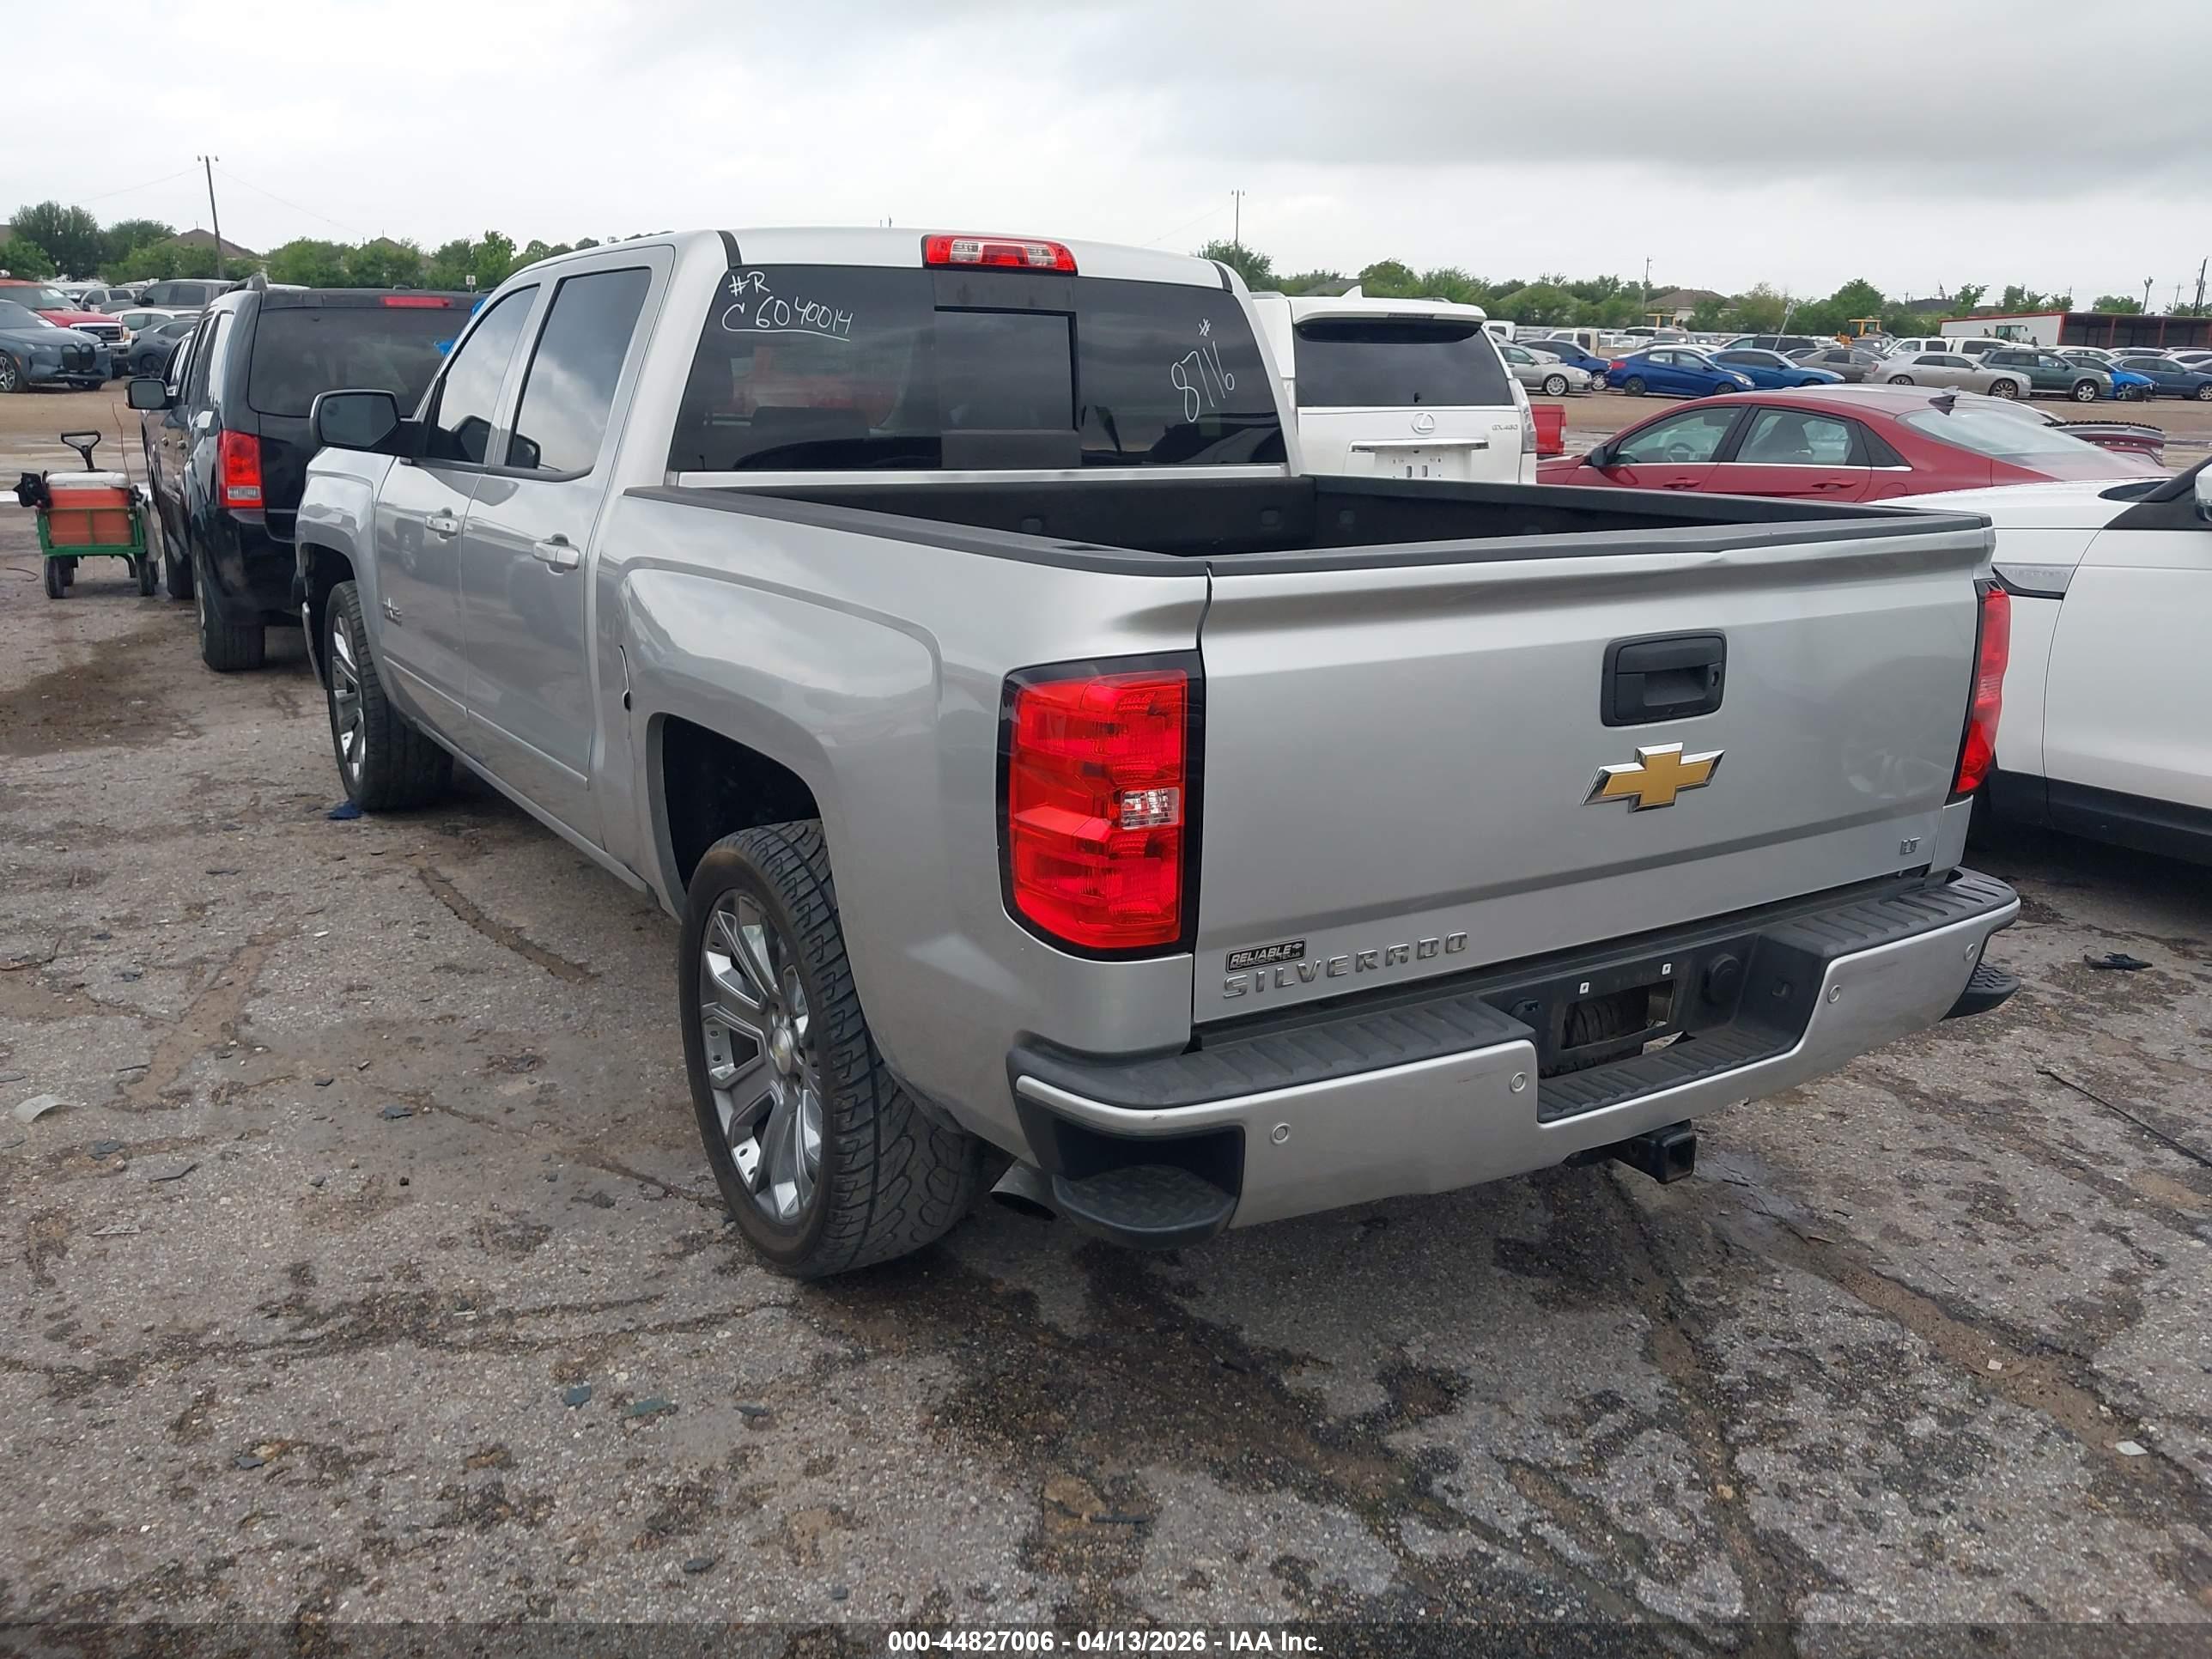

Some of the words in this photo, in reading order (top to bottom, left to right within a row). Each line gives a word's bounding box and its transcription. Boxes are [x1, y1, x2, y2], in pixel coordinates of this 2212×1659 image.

[1170, 340, 1236, 423] 8716
[1223, 931, 1468, 1000] SILVERADO
[1231, 945, 1292, 965] RELIABLE
